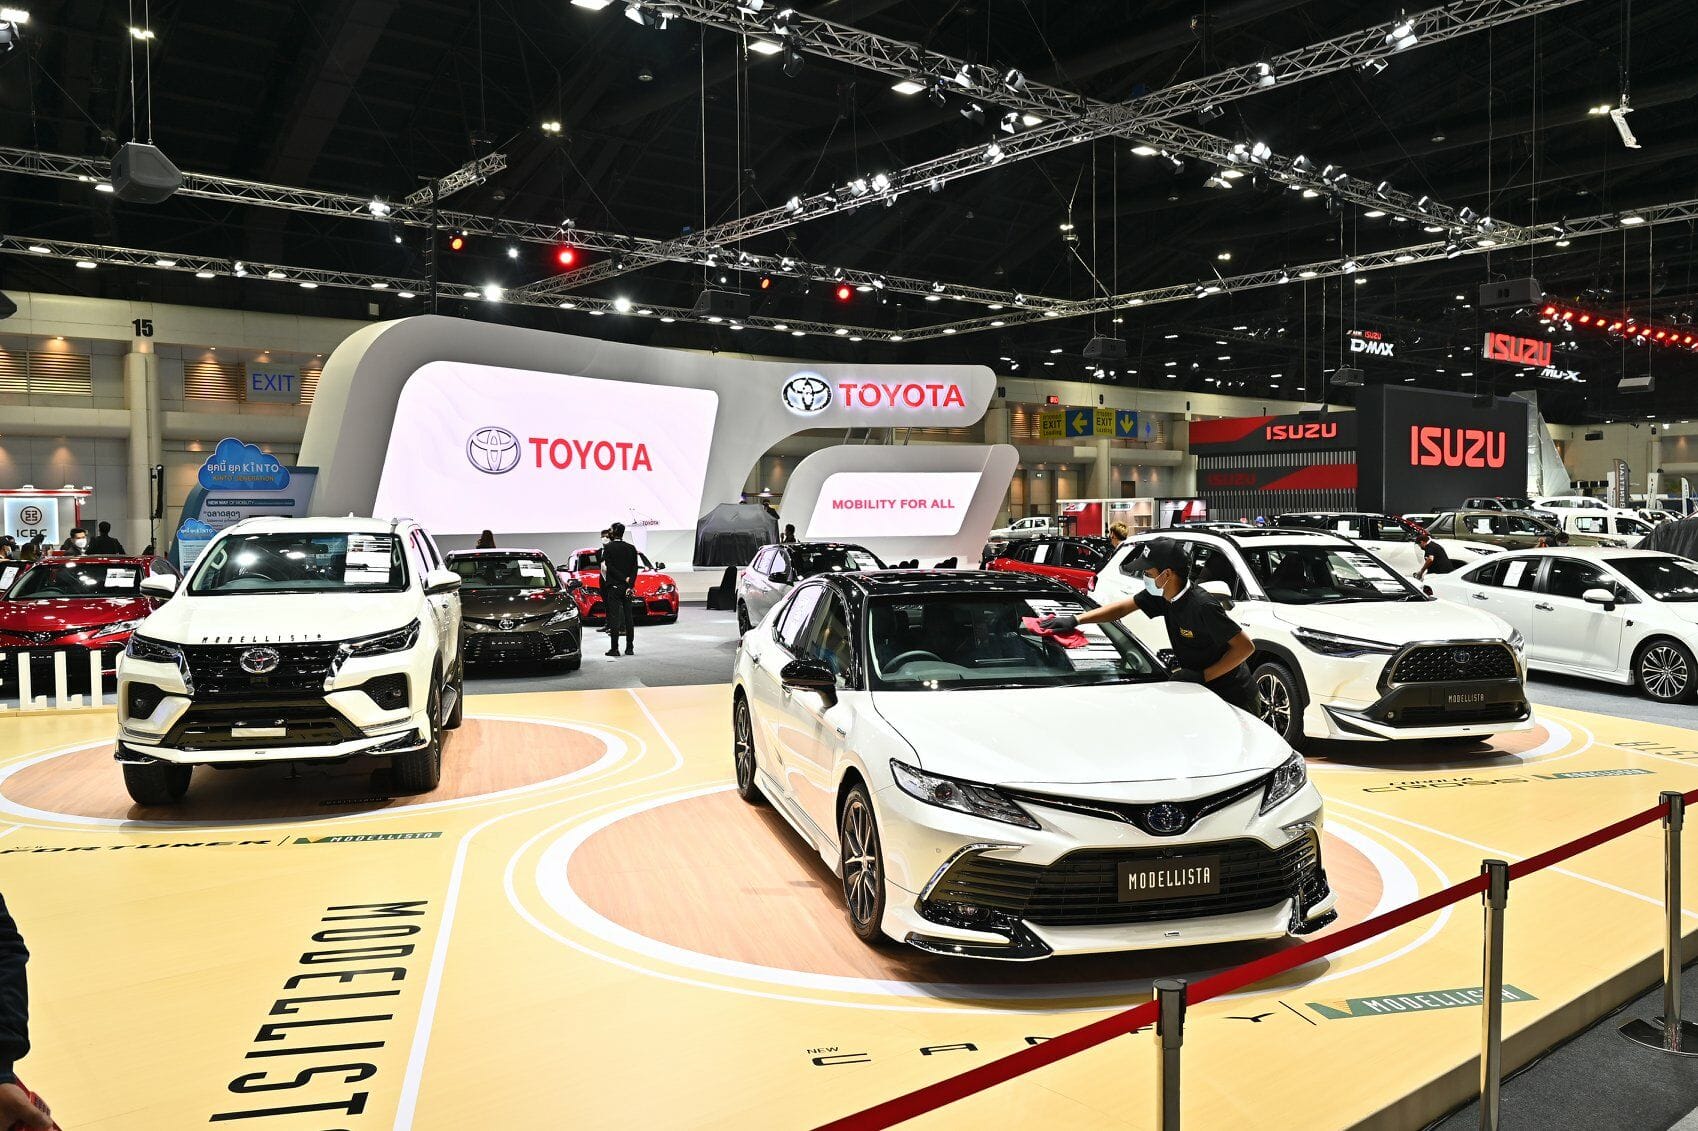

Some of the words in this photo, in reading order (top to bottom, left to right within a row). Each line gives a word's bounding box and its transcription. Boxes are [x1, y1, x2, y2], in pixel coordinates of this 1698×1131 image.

[132, 318, 154, 337] 15
[1364, 330, 1382, 340] ISUZU
[1487, 332, 1552, 367] ISUZU
[252, 373, 295, 392] EXIT
[838, 383, 966, 408] TOYOTA
[1043, 420, 1062, 429] EXIT
[1096, 417, 1112, 426] EXIT
[1266, 422, 1337, 440] ISUZU
[528, 437, 653, 472] TOYOTA
[1410, 425, 1506, 468] ISUZU
[1206, 473, 1257, 486] ISUZU
[832, 499, 896, 510] MOBILITY
[900, 499, 927, 509] FOR
[931, 499, 955, 509] ALL
[1448, 693, 1485, 703] MODELLISTA
[330, 832, 433, 843] MODELLISTA
[1128, 867, 1210, 890] MODELLISTA
[208, 900, 428, 1131] MODELLIST
[806, 1046, 839, 1054] NEW
